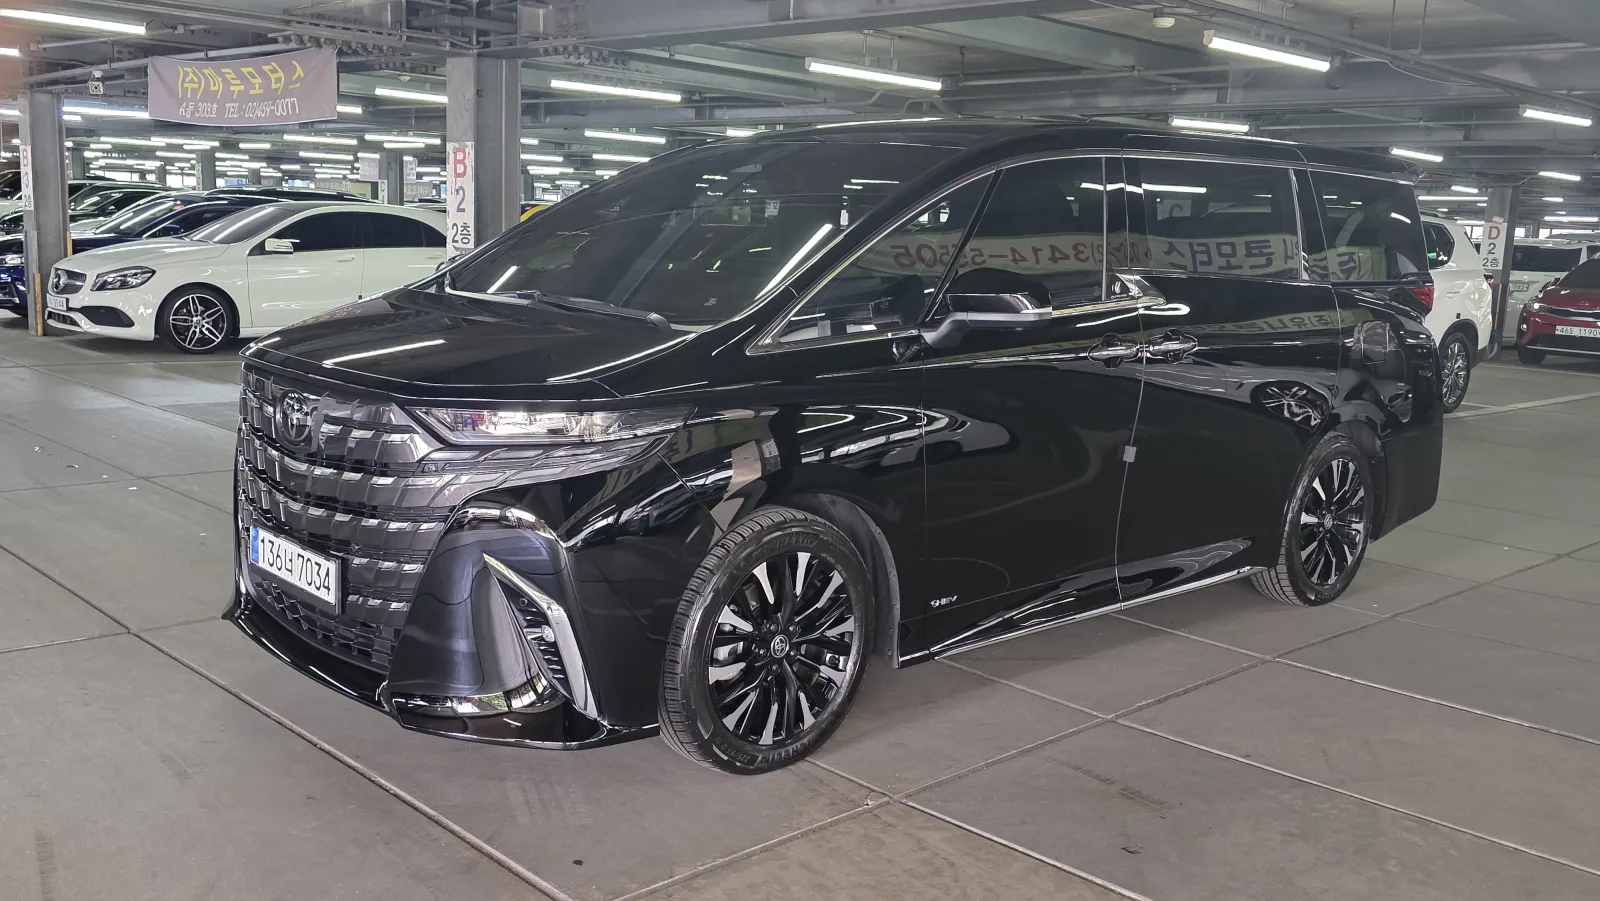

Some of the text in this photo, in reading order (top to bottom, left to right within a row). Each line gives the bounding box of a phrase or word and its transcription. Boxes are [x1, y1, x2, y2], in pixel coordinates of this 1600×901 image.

[178, 60, 304, 99] (주)마루모터스
[23, 149, 28, 167] B
[452, 147, 467, 178] B
[456, 186, 465, 212] 2
[452, 222, 471, 245] 2층
[1488, 226, 1500, 240] D
[1487, 242, 1496, 255] 2
[1482, 258, 1499, 268] 2층
[1578, 328, 1599, 337] 1190
[260, 536, 331, 596] 136너 7034
